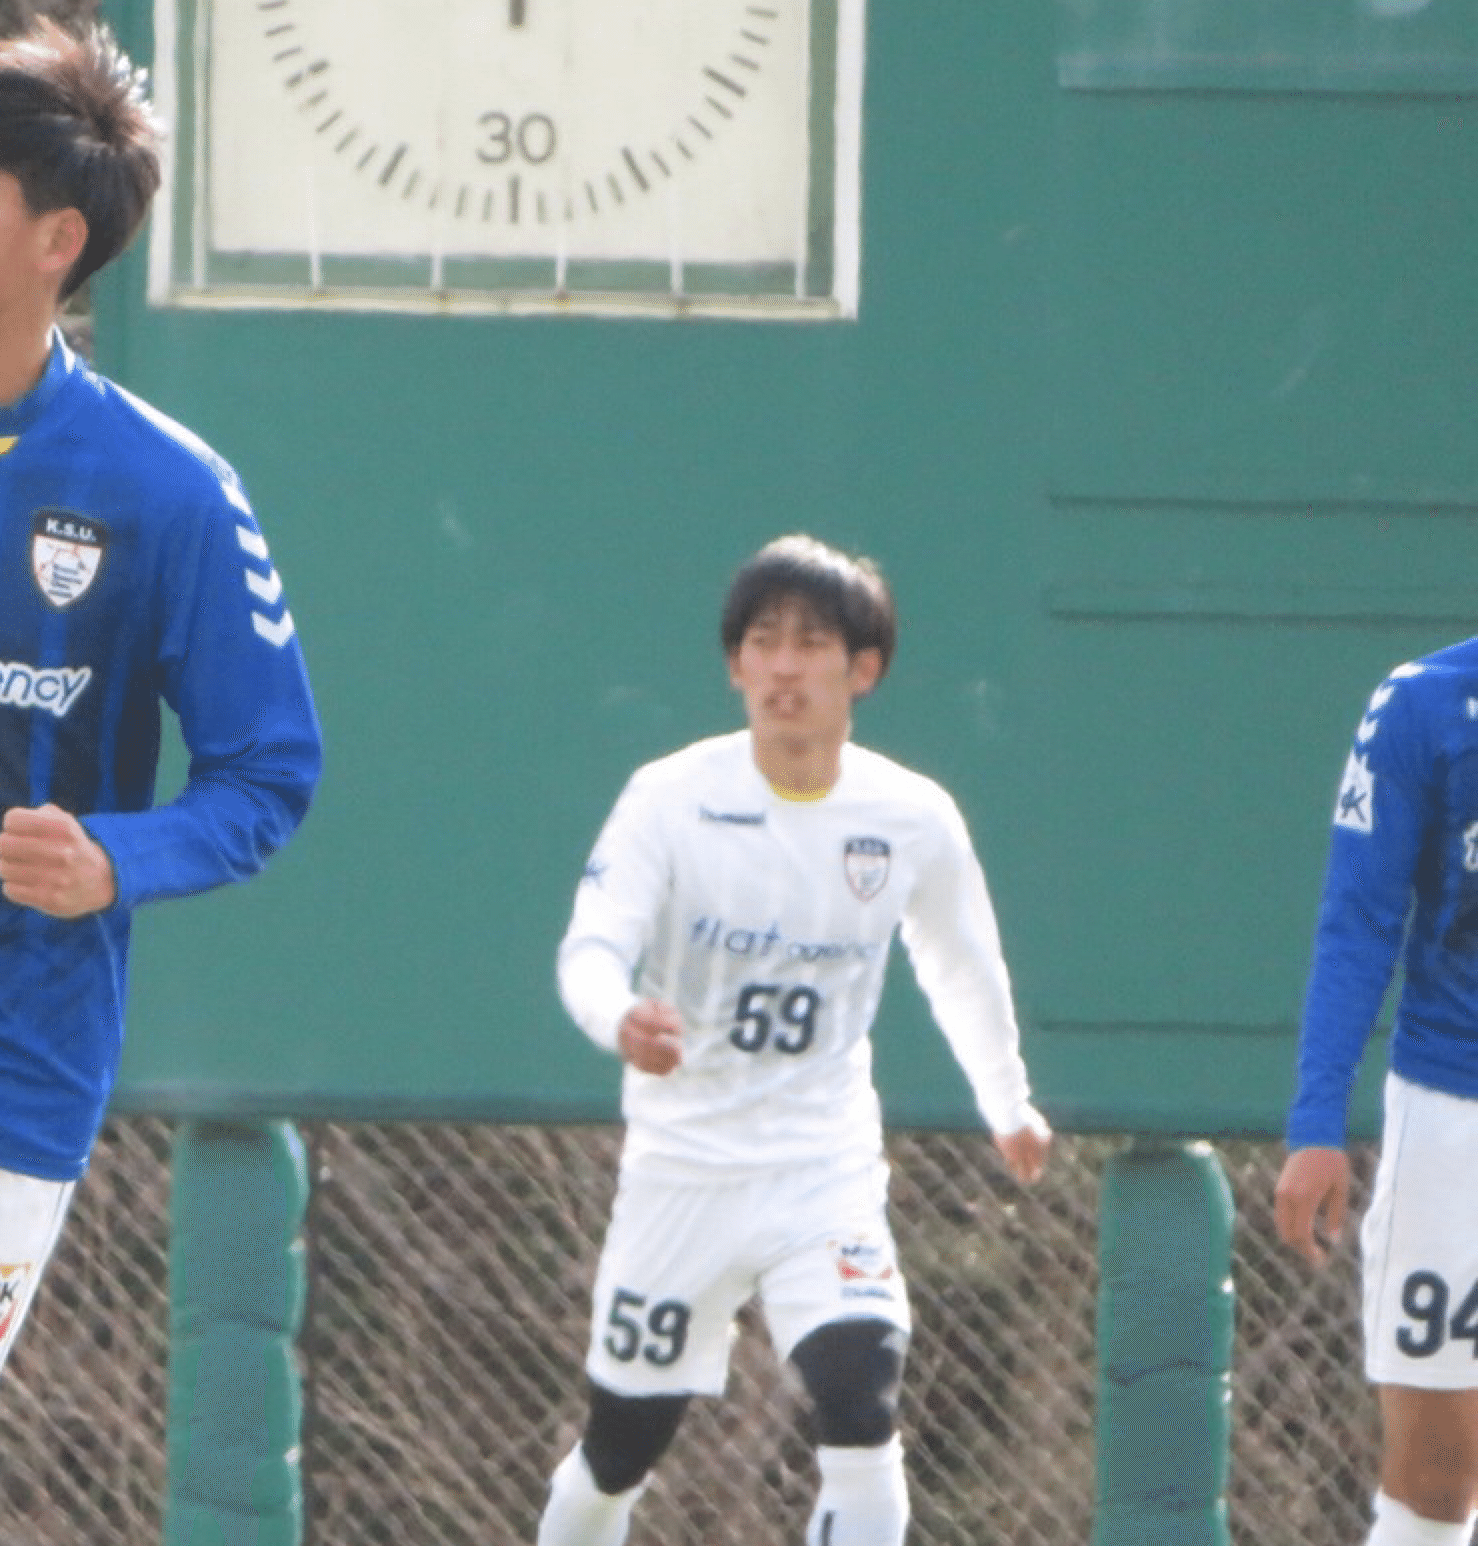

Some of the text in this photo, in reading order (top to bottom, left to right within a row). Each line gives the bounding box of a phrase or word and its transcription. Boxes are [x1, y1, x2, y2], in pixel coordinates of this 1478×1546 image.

[475, 110, 557, 165] 30
[729, 983, 821, 1054] 59
[603, 1287, 693, 1366] 59
